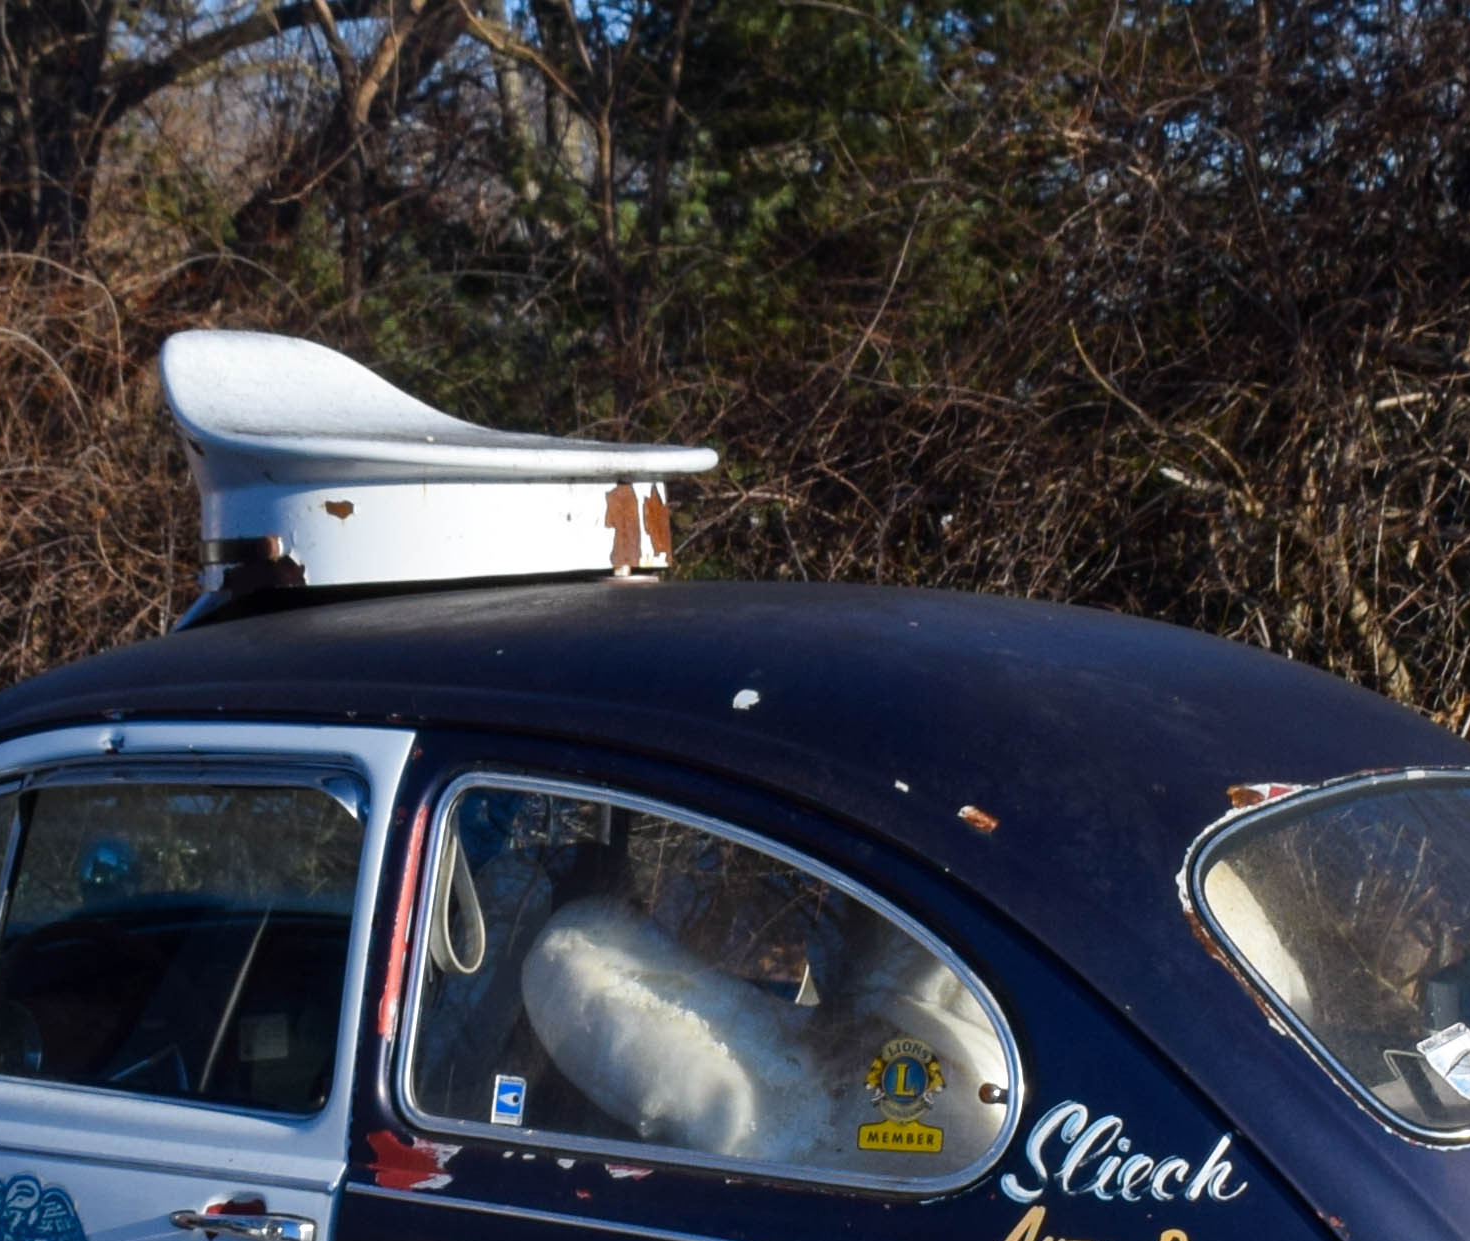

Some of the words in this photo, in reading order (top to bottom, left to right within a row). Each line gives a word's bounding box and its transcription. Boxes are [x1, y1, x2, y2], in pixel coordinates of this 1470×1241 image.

[888, 1041, 929, 1060] LIONS
[894, 1063, 916, 1096] L
[867, 1131, 935, 1145] MEMBER
[1001, 1100, 1248, 1202] Sliech
